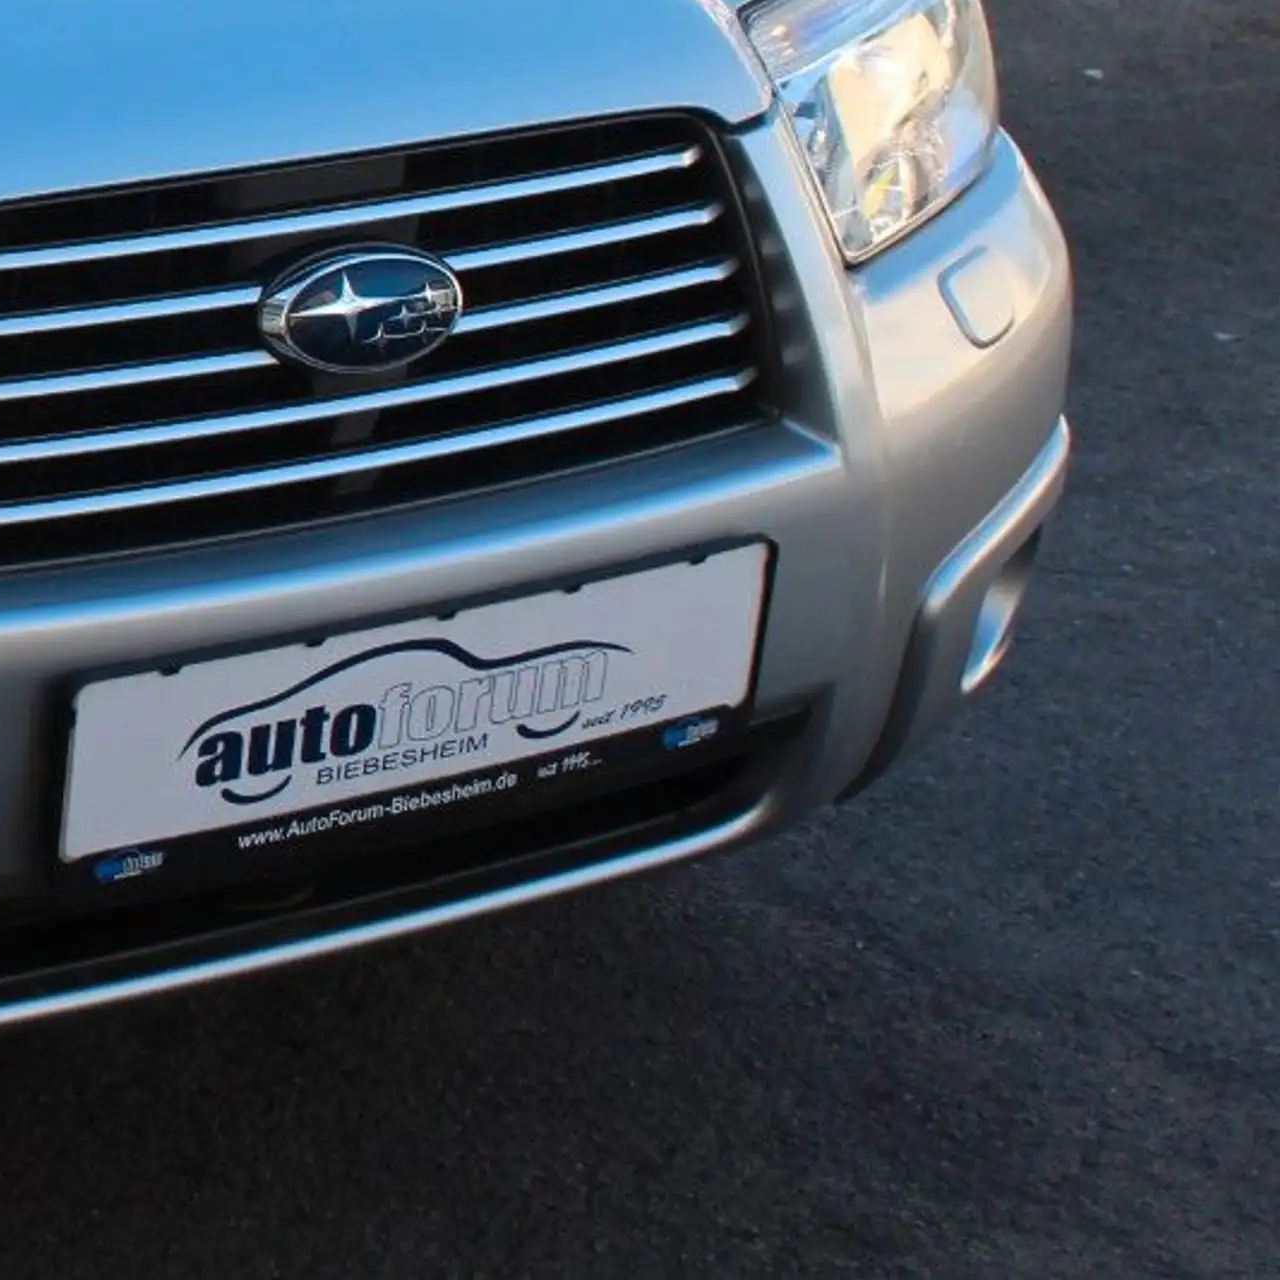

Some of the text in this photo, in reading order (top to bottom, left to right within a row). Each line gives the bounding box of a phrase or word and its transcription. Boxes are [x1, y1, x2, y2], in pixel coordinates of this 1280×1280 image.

[195, 649, 609, 787] autoforum
[316, 732, 489, 785] BIEBESHEIM
[238, 770, 519, 850] www.AutoForum-Biebesheim.de
